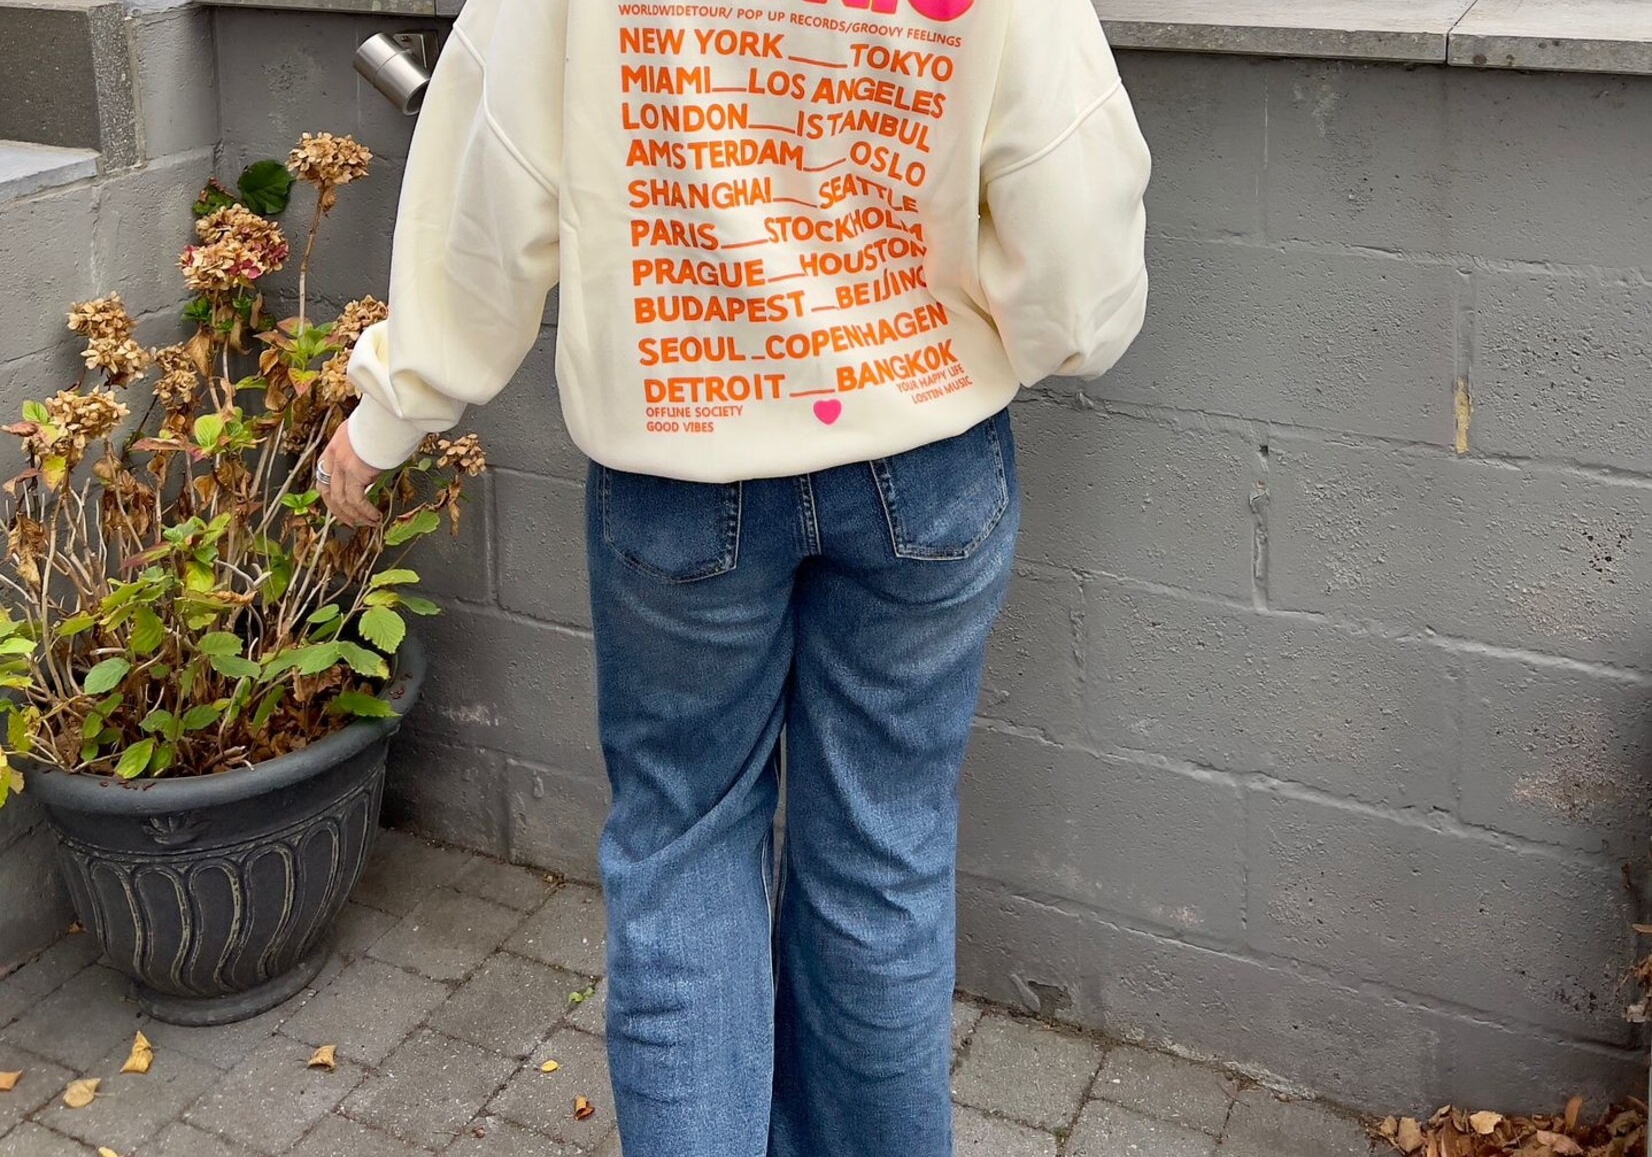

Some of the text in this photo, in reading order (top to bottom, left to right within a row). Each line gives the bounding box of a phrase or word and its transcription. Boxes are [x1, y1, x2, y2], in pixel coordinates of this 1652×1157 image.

[737, 8, 763, 20] POP
[768, 11, 785, 22] UP
[907, 28, 962, 48] FEELINGS
[619, 27, 954, 82] NEW YORK TOKYO
[621, 65, 947, 119] MIAMI LOS ANGELES
[622, 103, 930, 153] LONDON ISTANBUL
[626, 139, 926, 187] AMSTERDAM OSLO
[628, 173, 919, 213] SHANGHAI SEATTLE
[631, 207, 924, 250] PARIS STOCKHOLM
[633, 237, 927, 287] PRAGUE HOUSTON
[634, 291, 804, 324] BUDAPEST
[638, 301, 949, 366] SEOUL COPENHAGEN
[644, 338, 958, 403] DETROIT BANGKOK
[896, 364, 965, 393] YOUR HAPPY LIFE
[944, 375, 973, 394] MUSIC
[646, 405, 743, 417] OFFLINE SOCIETY
[646, 421, 714, 432] GOOD VIBES
